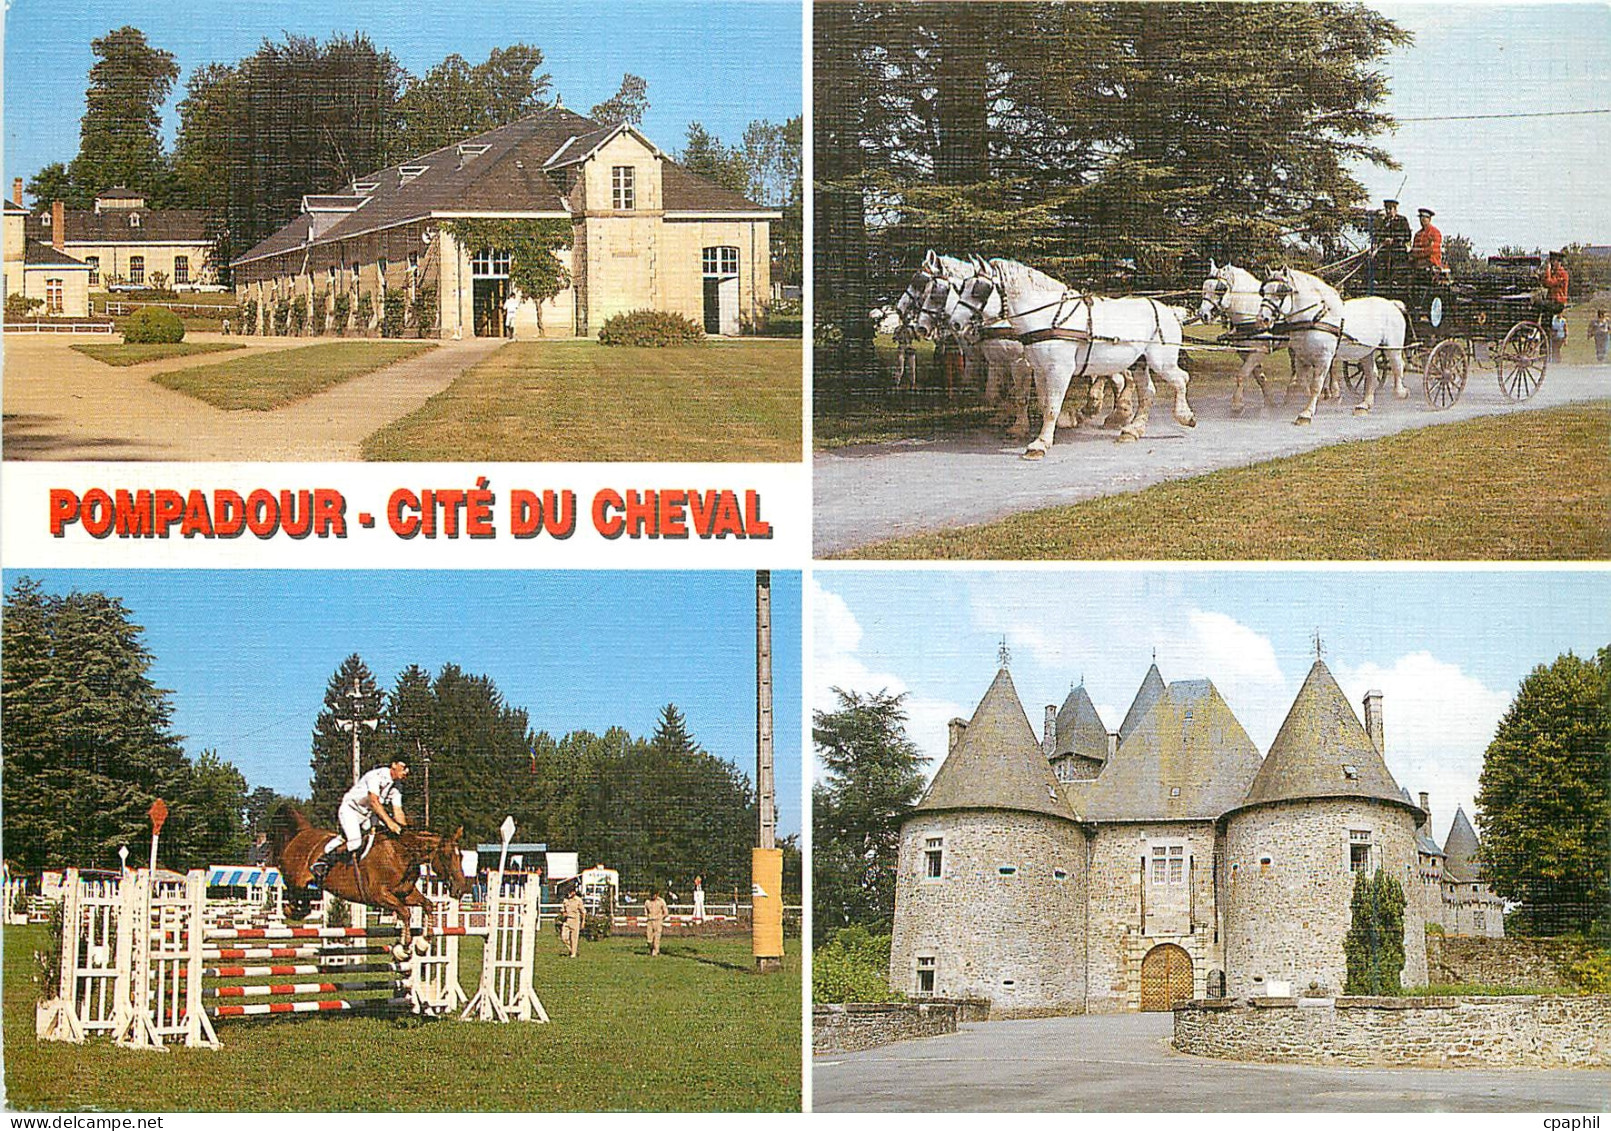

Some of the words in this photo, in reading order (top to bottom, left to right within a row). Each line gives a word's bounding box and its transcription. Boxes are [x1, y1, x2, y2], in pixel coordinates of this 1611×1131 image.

[49, 487, 348, 540] POMPADOUR
[358, 512, 375, 528] -
[387, 476, 497, 540] CITÉ
[510, 488, 577, 540] DU
[591, 488, 774, 540] CHEVAL
